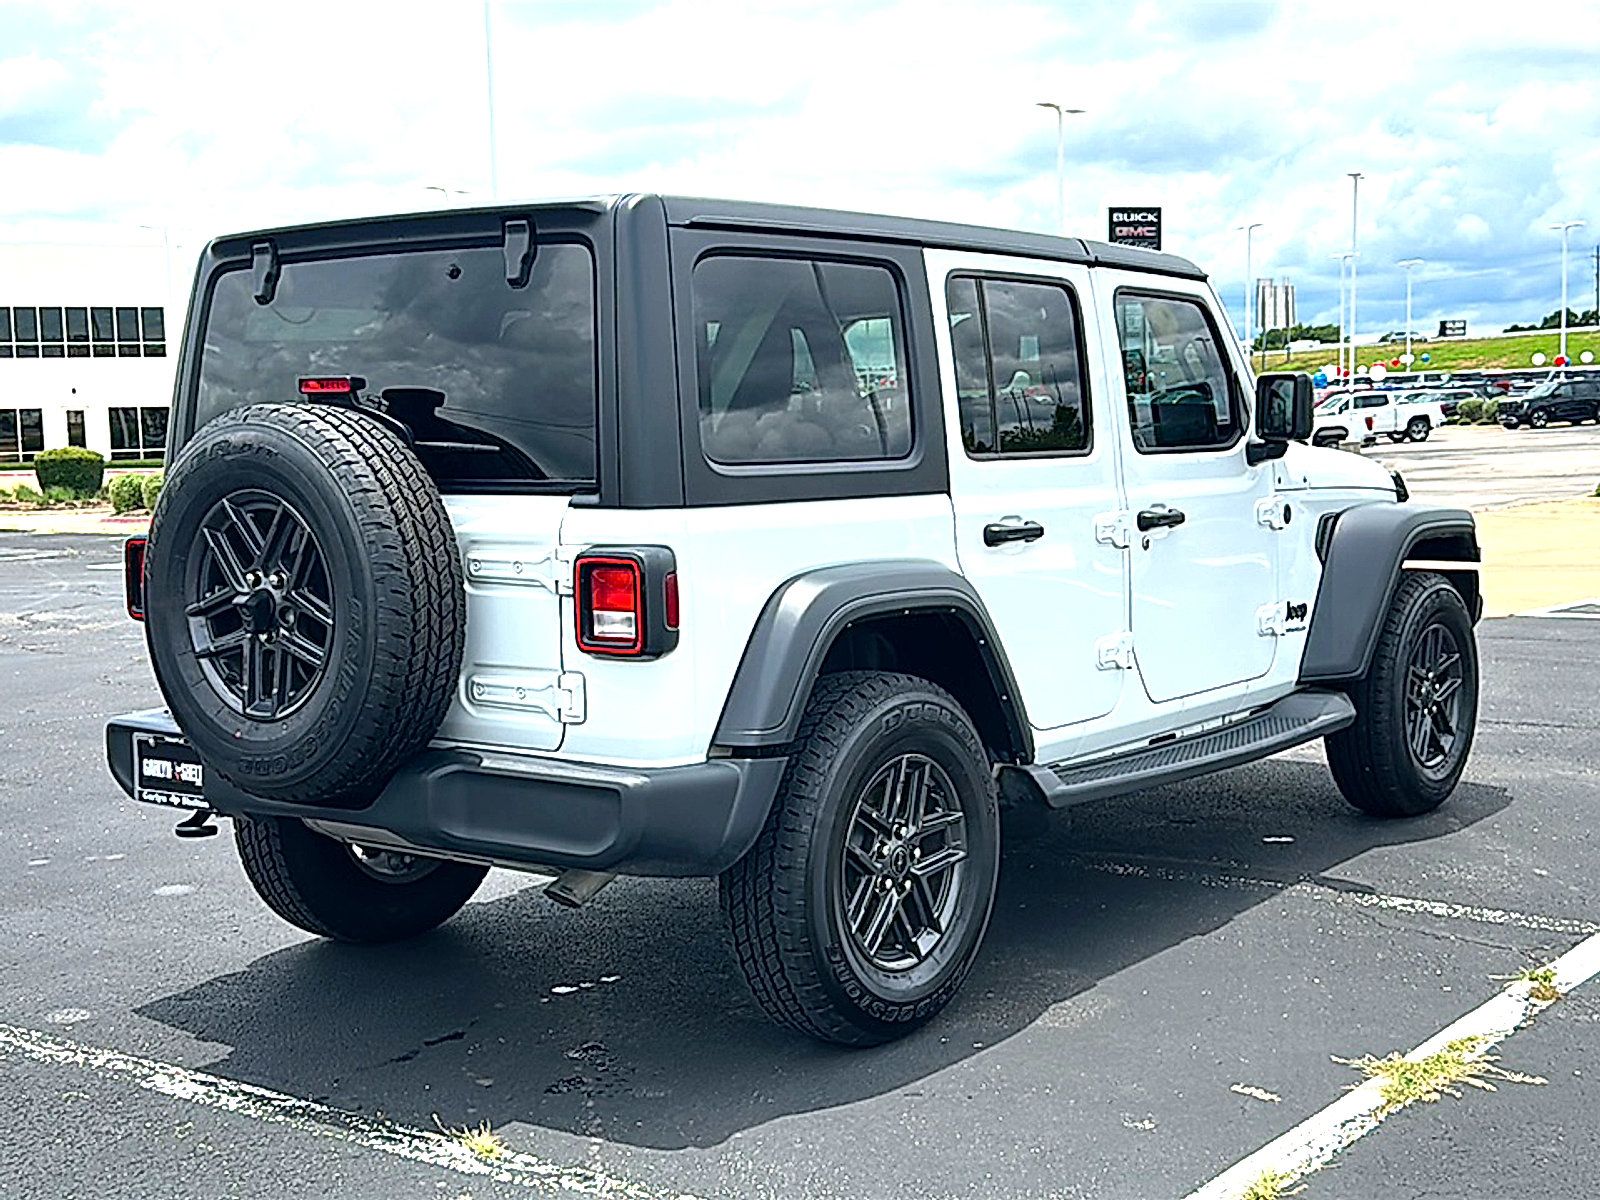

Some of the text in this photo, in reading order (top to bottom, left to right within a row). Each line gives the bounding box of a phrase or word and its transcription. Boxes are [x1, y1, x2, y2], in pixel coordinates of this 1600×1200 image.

[1112, 211, 1159, 223] BUICK
[1114, 226, 1157, 237] GMC
[1285, 600, 1308, 622] Jeep
